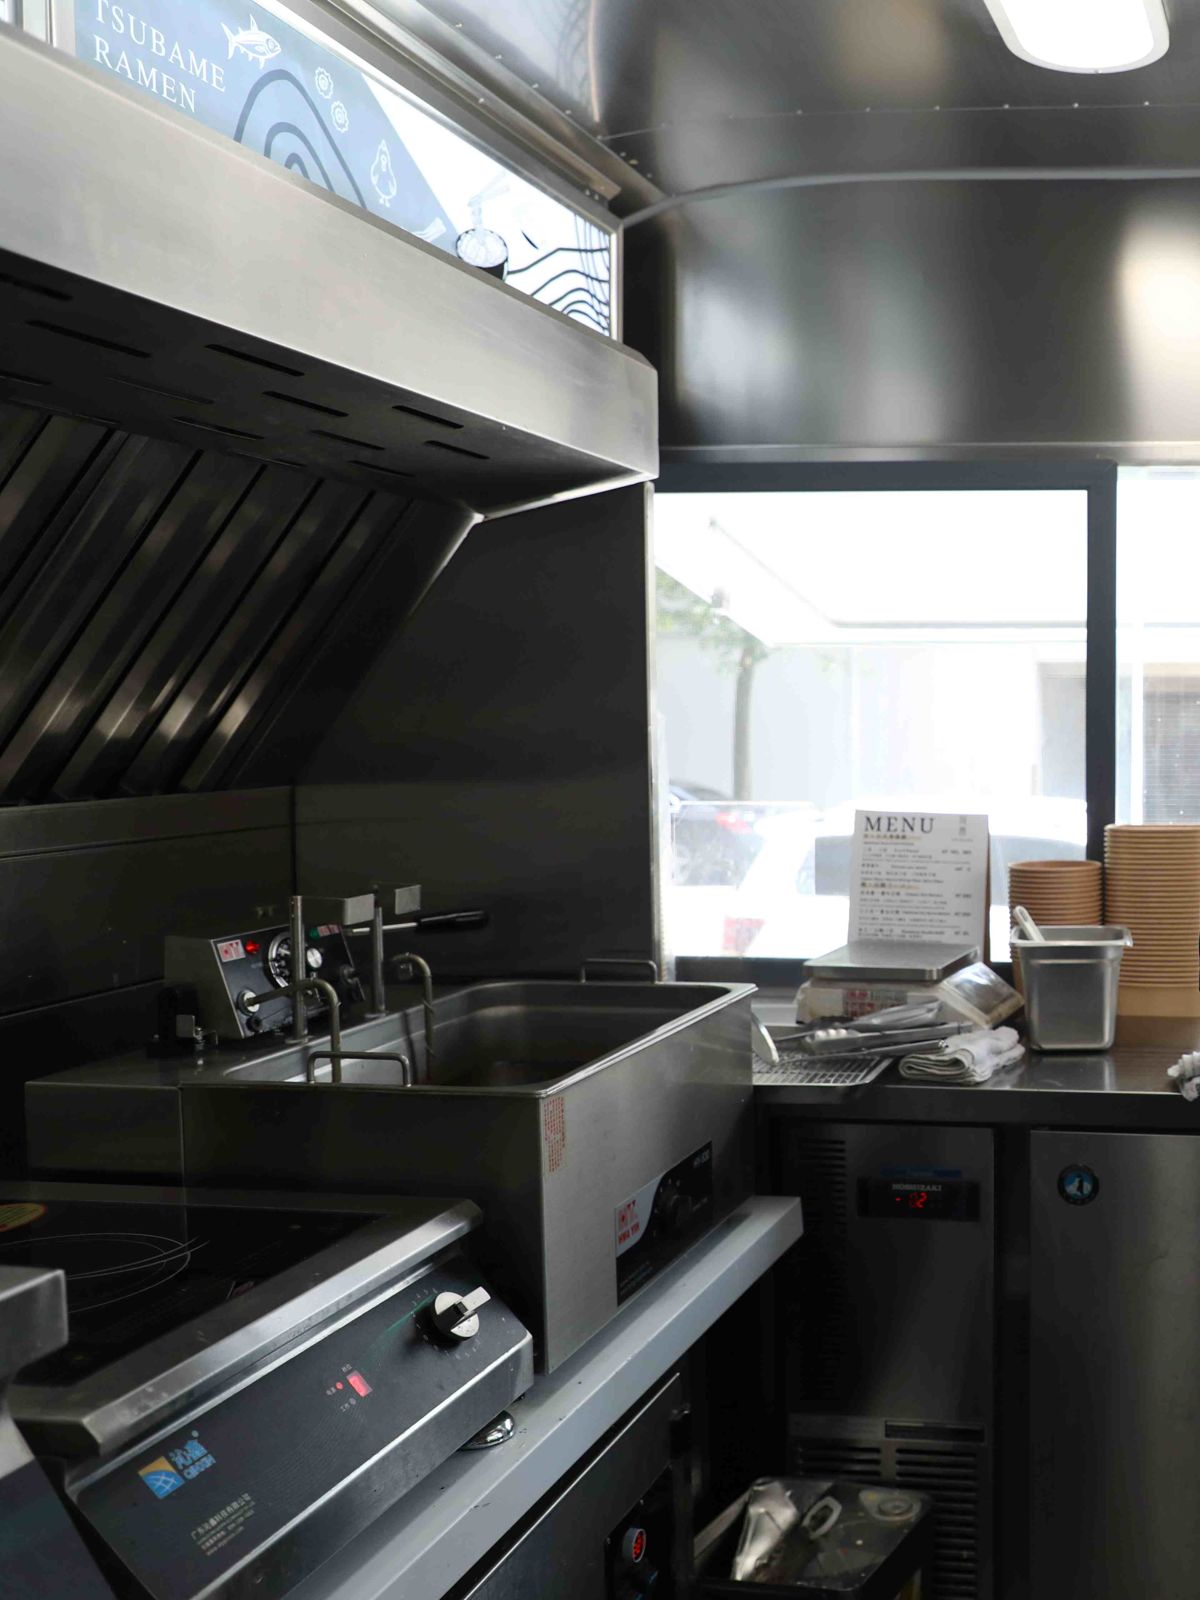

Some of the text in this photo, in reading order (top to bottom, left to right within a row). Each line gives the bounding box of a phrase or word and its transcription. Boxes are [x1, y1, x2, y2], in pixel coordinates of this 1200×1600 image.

[92, 34, 197, 113] RAMEN
[94, 0, 227, 92] TSUBAME
[864, 815, 935, 834] MENU
